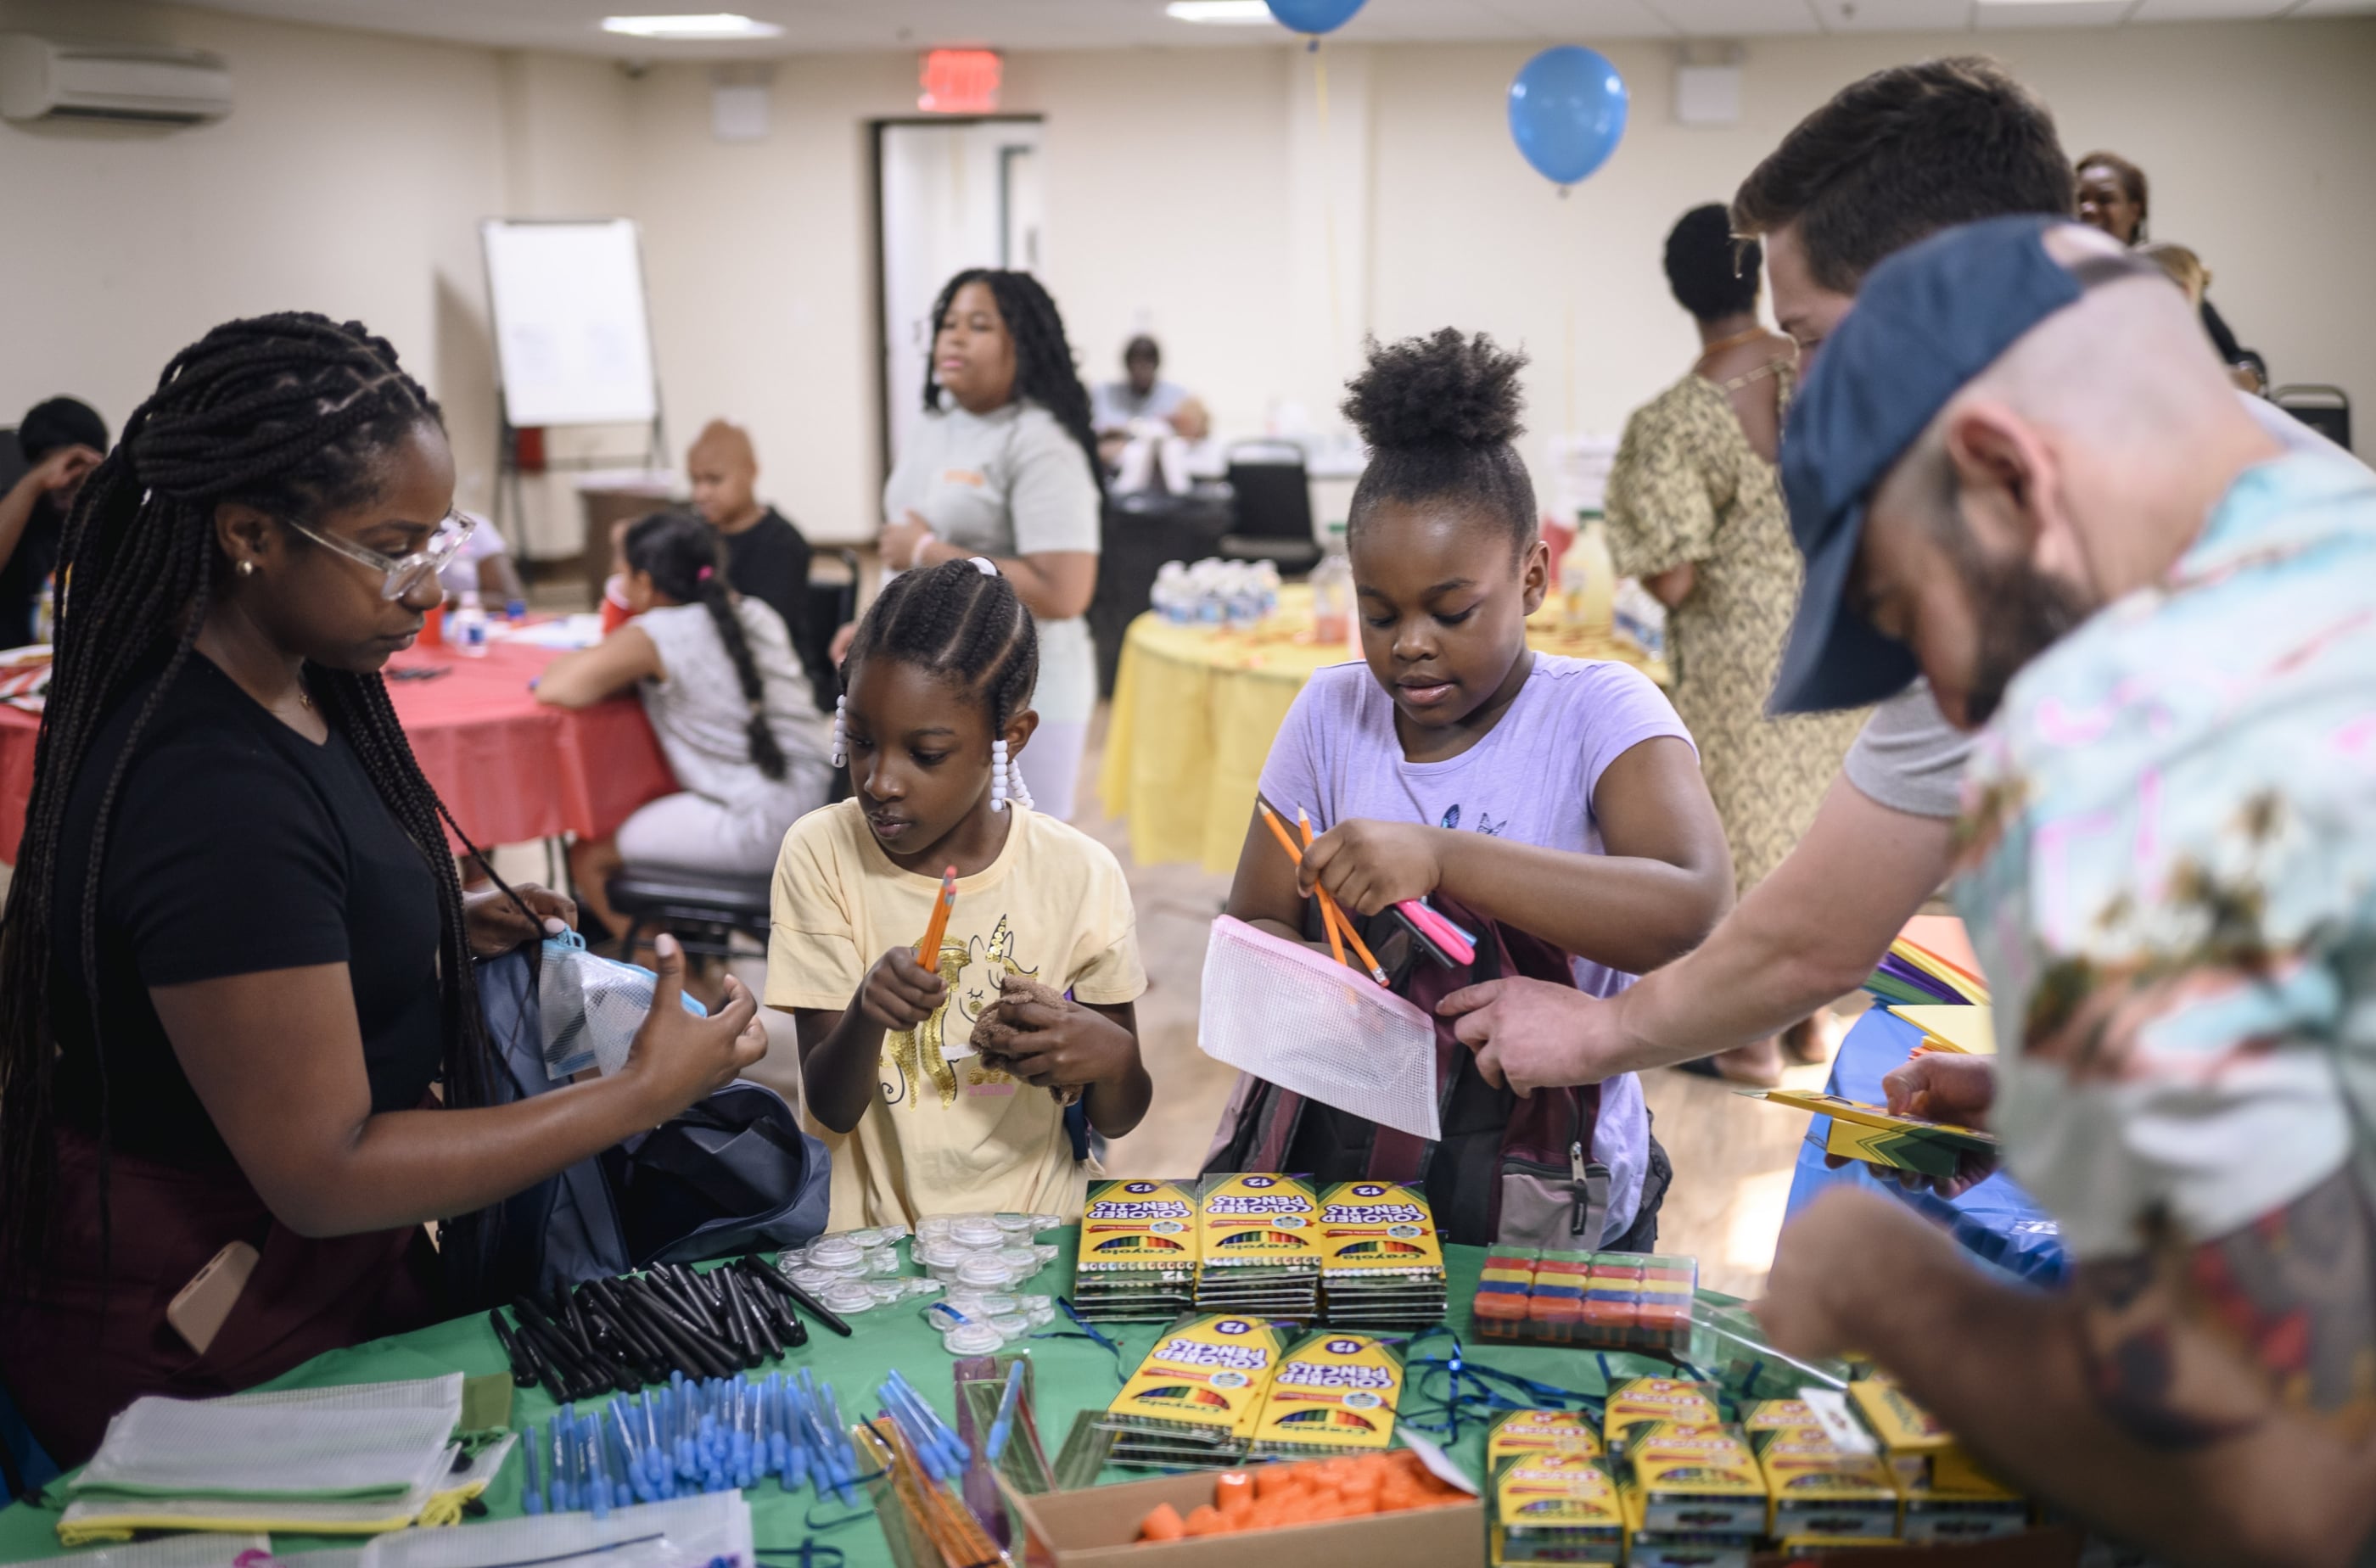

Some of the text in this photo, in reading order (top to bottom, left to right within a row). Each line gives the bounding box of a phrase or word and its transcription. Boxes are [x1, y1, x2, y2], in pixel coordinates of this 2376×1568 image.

[1129, 1184, 1153, 1192] 12
[1247, 1179, 1270, 1187] 12
[1357, 1187, 1381, 1196] 12
[1094, 1201, 1186, 1212] PENCILS
[1213, 1196, 1306, 1207] PENCILS
[1087, 1209, 1192, 1219] COLORED
[1207, 1204, 1314, 1214] COLORED
[1325, 1204, 1419, 1216] PENCILS
[1320, 1212, 1427, 1224] COLORED
[1160, 1271, 1186, 1281] 12
[1220, 1322, 1246, 1334] 12
[1168, 1338, 1267, 1361] PENCILS
[1331, 1341, 1356, 1353] 12
[1154, 1348, 1268, 1370] COLORED
[1286, 1361, 1389, 1379] PENCILS
[1276, 1372, 1395, 1390] COLORED
